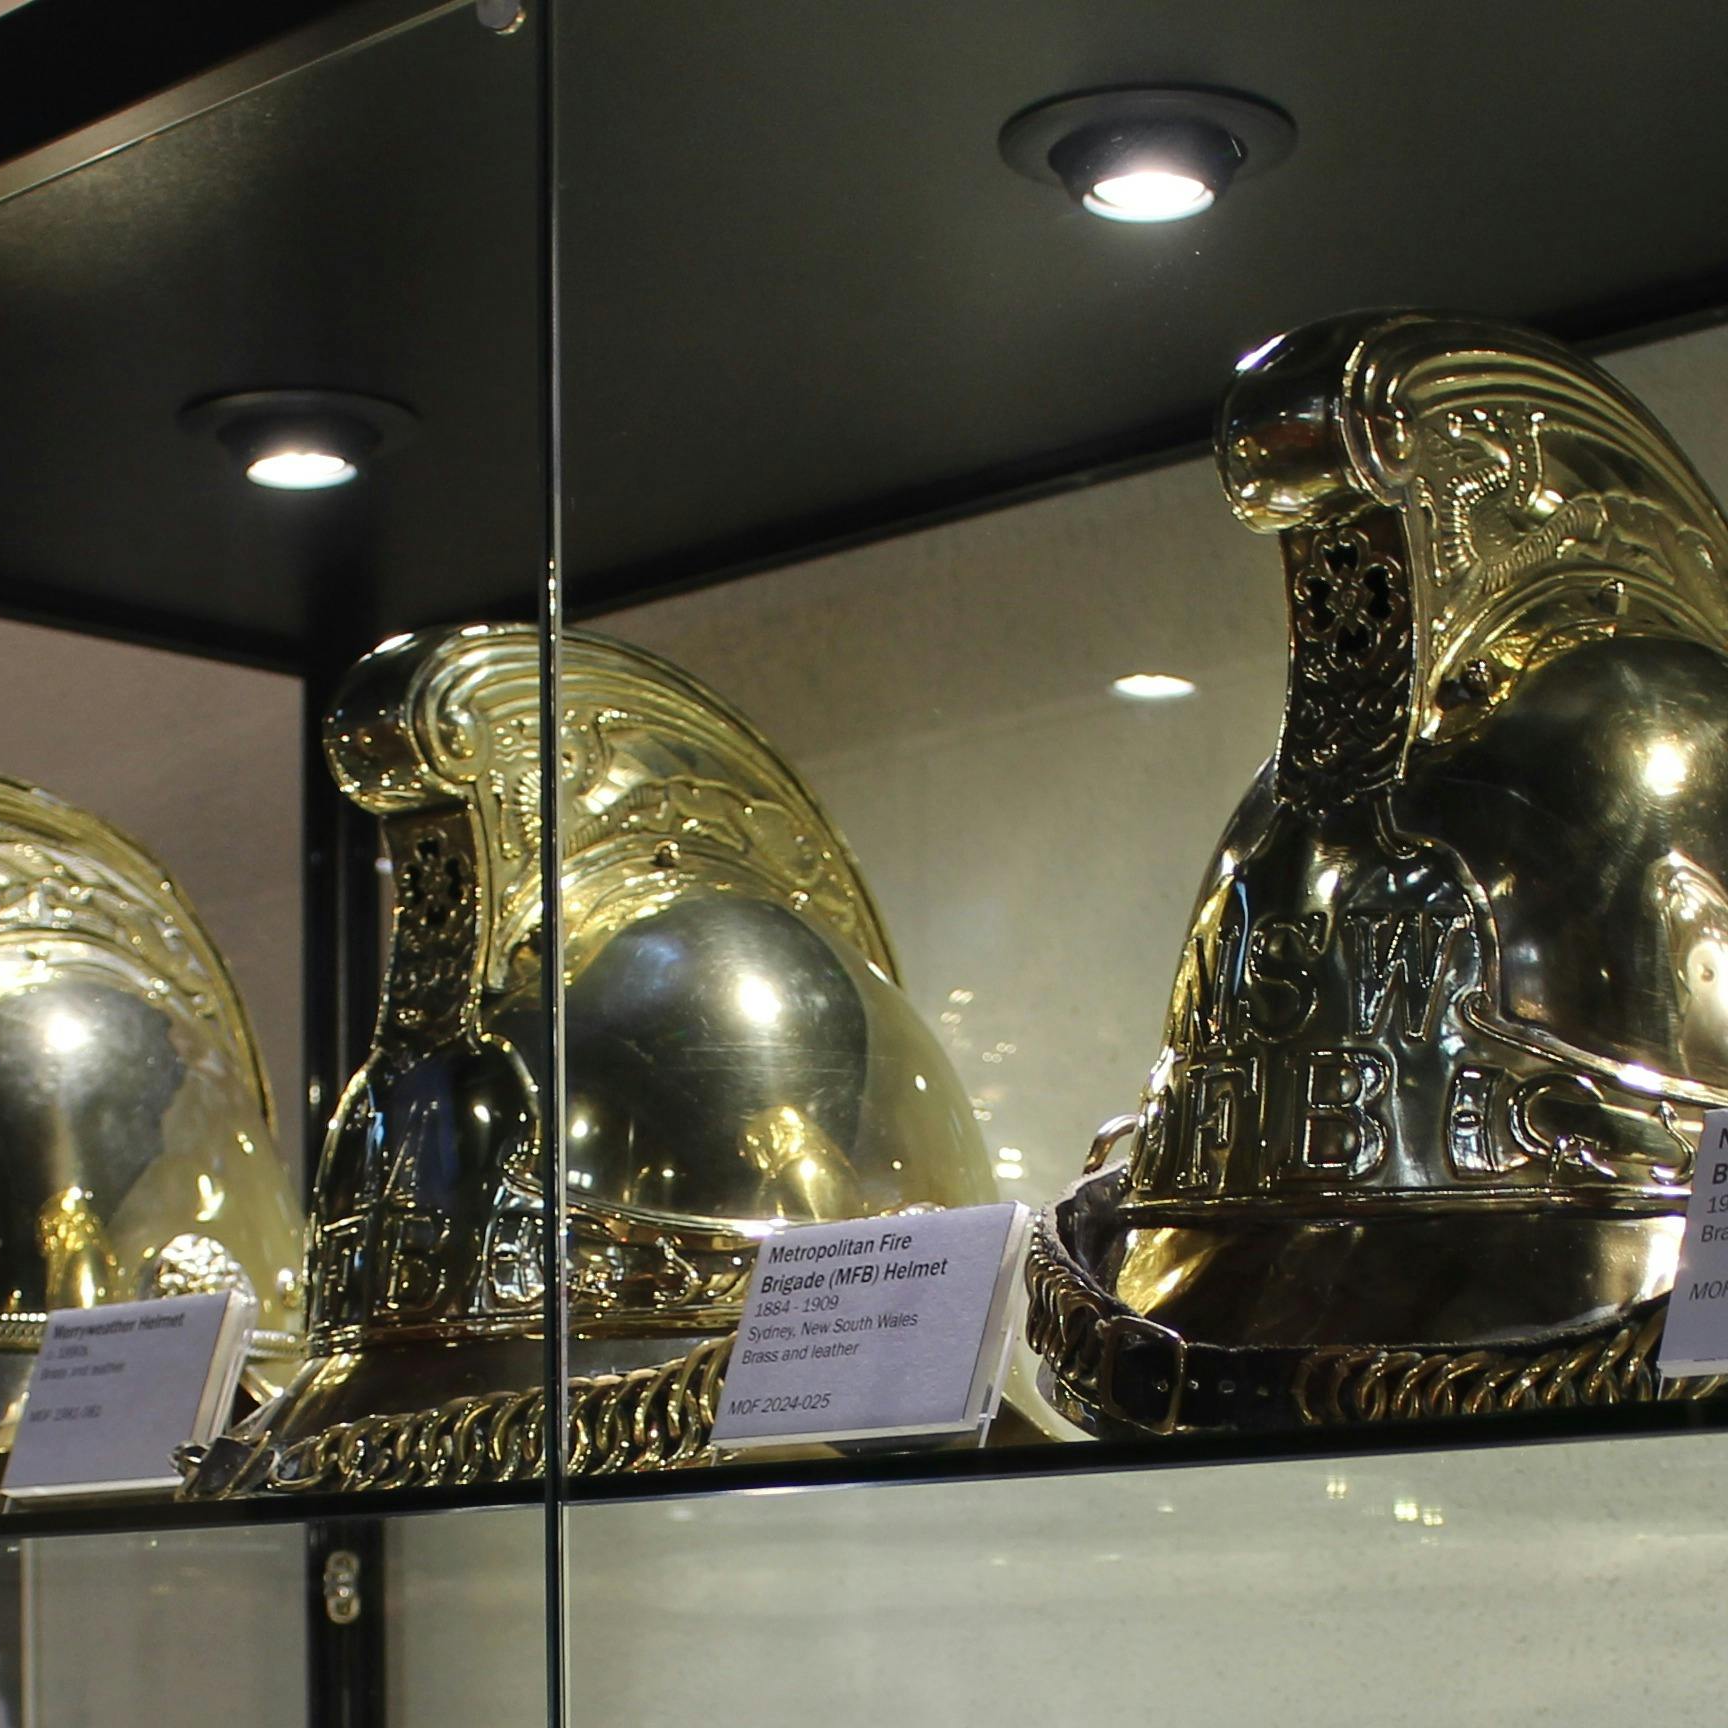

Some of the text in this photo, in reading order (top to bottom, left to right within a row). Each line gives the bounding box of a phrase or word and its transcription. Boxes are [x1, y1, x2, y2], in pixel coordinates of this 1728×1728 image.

[768, 1233, 912, 1265] Metropolitan Fire
[761, 1257, 948, 1296] Brigade (MFB) Helmet
[754, 1299, 790, 1317] 1884
[802, 1295, 839, 1313] 1909
[137, 1313, 186, 1329] Helmet
[747, 1312, 918, 1344] Sydney, New South Wales
[741, 1341, 860, 1365] Brass and leather
[728, 1392, 831, 1415] MOF 2024-025
